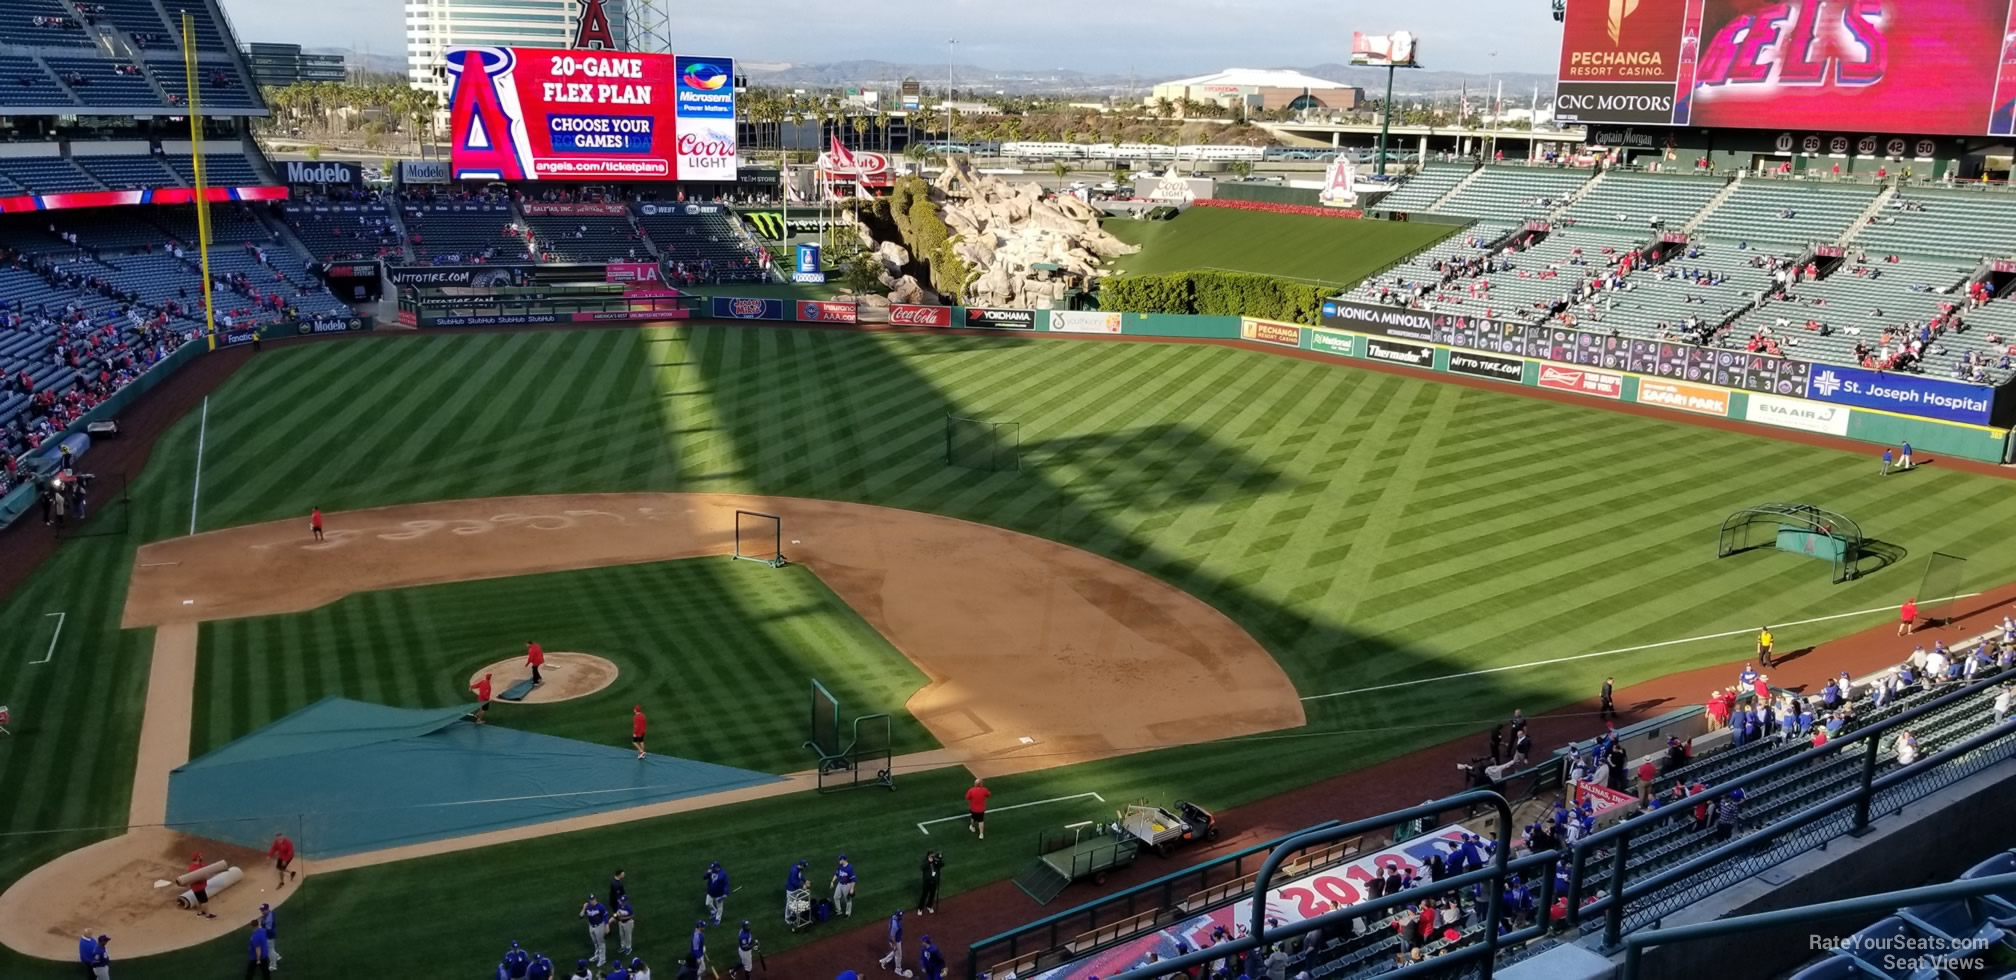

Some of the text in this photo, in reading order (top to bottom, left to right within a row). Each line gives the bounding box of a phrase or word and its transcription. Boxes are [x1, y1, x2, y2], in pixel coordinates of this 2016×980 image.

[1571, 52, 1662, 65] PECHANGA
[551, 56, 643, 78] 20-GAME
[1570, 66, 1662, 76] RESORT CASINO
[542, 82, 652, 104] FLEX PLAN
[680, 91, 732, 102] Microsemi
[1558, 94, 1671, 112] CNC MOTORS
[551, 118, 650, 133] CHOOSE YOUR
[574, 135, 623, 148] GAMES
[624, 136, 630, 148] !
[1595, 128, 1652, 146] Captain Morgan
[678, 133, 735, 156] Coors
[1780, 138, 1789, 148] 11
[1804, 138, 1818, 149] 26
[1832, 140, 1846, 150] 29
[1860, 140, 1874, 151] 30
[1888, 142, 1904, 152] 42
[1918, 142, 1933, 153] 50
[536, 160, 666, 174] angels.com/ticketplans
[688, 158, 728, 168] LIGHT
[287, 162, 350, 182] Modelo
[408, 164, 444, 178] Modelo
[1158, 178, 1190, 190] Coors
[392, 272, 470, 284] NITTOTIRE.COM
[637, 267, 657, 281] LA
[891, 306, 939, 324] Coca-Cola
[984, 311, 1031, 320] YOKOHAMA
[1337, 305, 1431, 329] KONICA MINOLTA
[314, 320, 346, 332] Modelo
[1446, 317, 1452, 325] 3
[1258, 325, 1298, 338] PECHANGA
[1494, 323, 1498, 331] 1
[1504, 324, 1514, 336] P
[1518, 326, 1524, 335] 7
[1443, 334, 1452, 343] 10
[1543, 330, 1548, 338] 1
[1568, 333, 1574, 342] 4
[1322, 335, 1352, 348] National
[1490, 341, 1498, 350] 11
[1594, 337, 1601, 345] 5
[1621, 340, 1628, 349] 5
[1538, 348, 1549, 356] 16
[1649, 344, 1655, 352] 6
[1678, 348, 1684, 356] 6
[1368, 344, 1421, 363] Thermador
[1566, 352, 1572, 360] 6
[1707, 352, 1713, 361] 2
[1592, 356, 1598, 364] 3
[1620, 360, 1625, 368] 1
[1735, 356, 1746, 365] 11
[1768, 360, 1774, 369] 8
[1451, 356, 1521, 376] NITTO TIRE.COM
[1647, 364, 1653, 372] 2
[1799, 365, 1805, 374] 3
[1584, 372, 1600, 382] THIS
[1675, 368, 1681, 376] 5
[1704, 372, 1710, 380] 4
[1583, 381, 1596, 389] FOR
[1734, 376, 1741, 385] 7
[1764, 381, 1771, 390] 3
[1795, 385, 1802, 394] 4
[1642, 389, 1723, 412] SAFARI PARK
[1844, 381, 1987, 412] St. Joseph Hospital
[1580, 782, 1610, 800] SALINAS,
[1278, 854, 1418, 920] 2018
